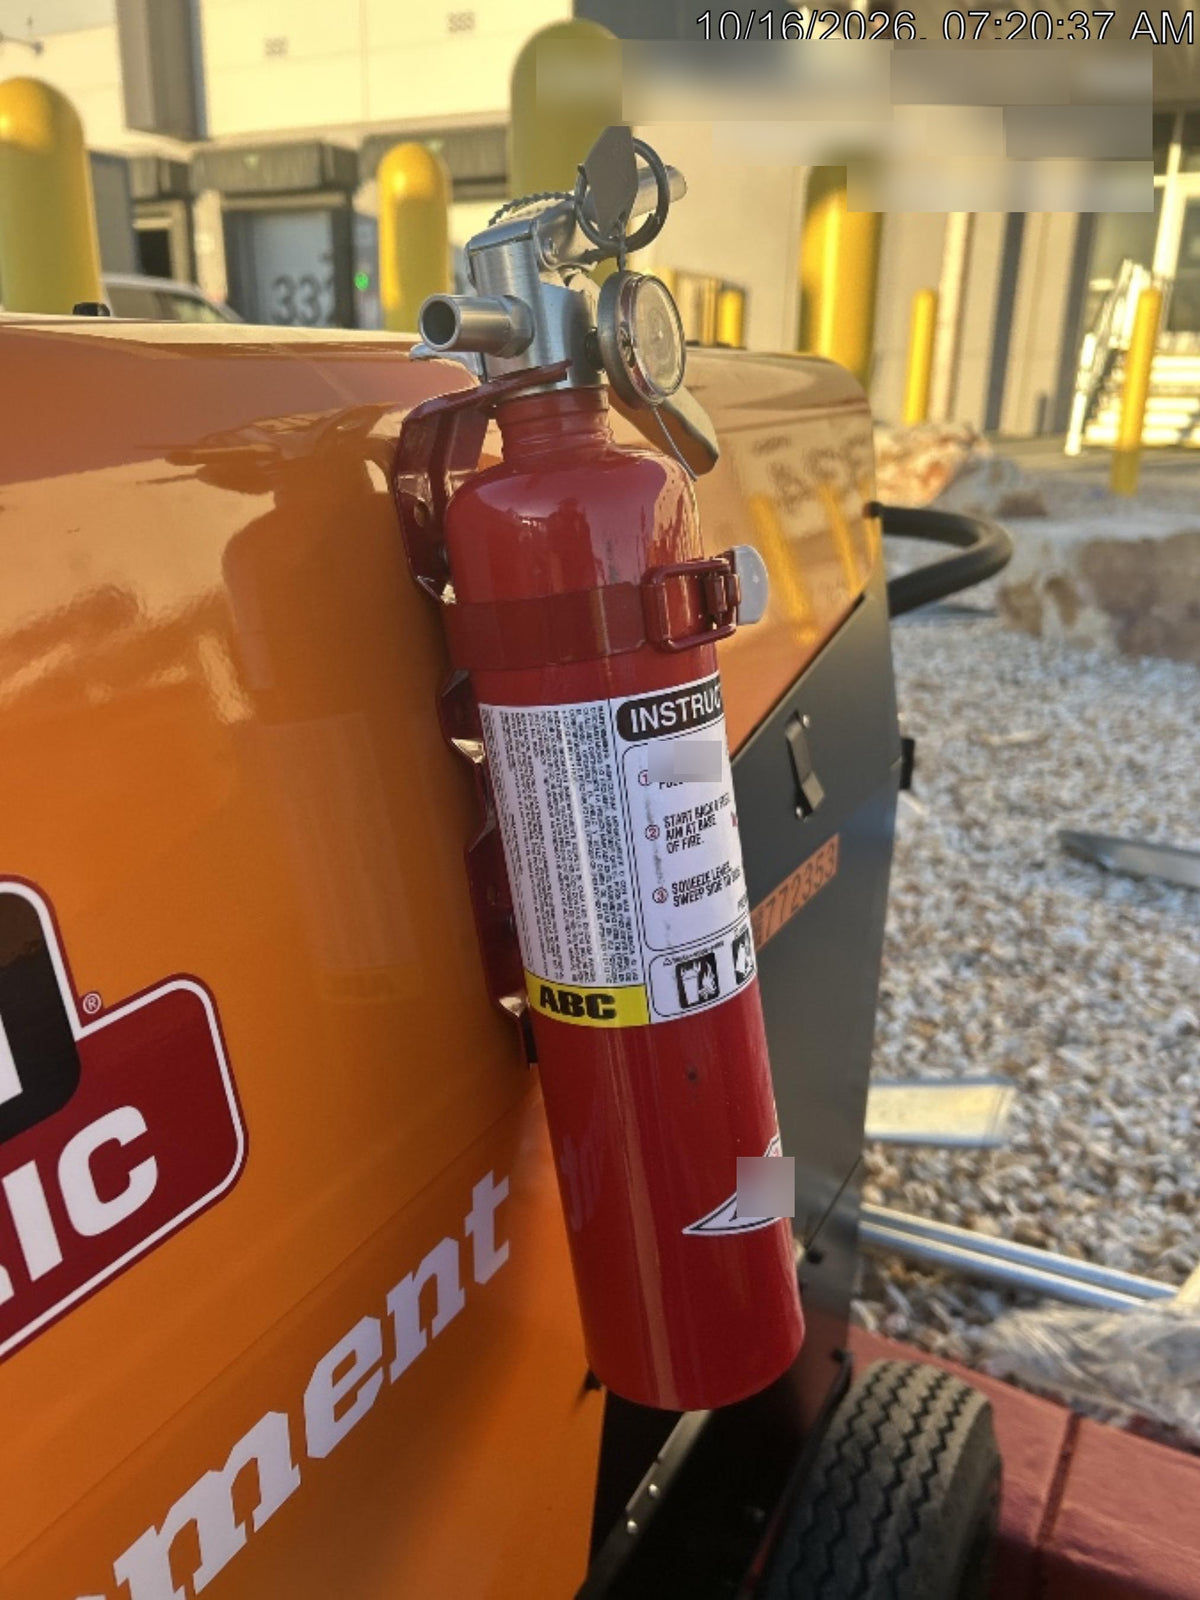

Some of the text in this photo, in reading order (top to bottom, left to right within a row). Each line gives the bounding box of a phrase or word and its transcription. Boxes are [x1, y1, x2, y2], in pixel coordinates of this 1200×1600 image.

[663, 808, 692, 828] START
[686, 821, 696, 836] AT
[666, 840, 680, 854] OF
[673, 887, 705, 907] SWEEP
[540, 984, 617, 1020] ABC
[0, 1105, 158, 1301] IC
[75, 1169, 510, 1600] ment
